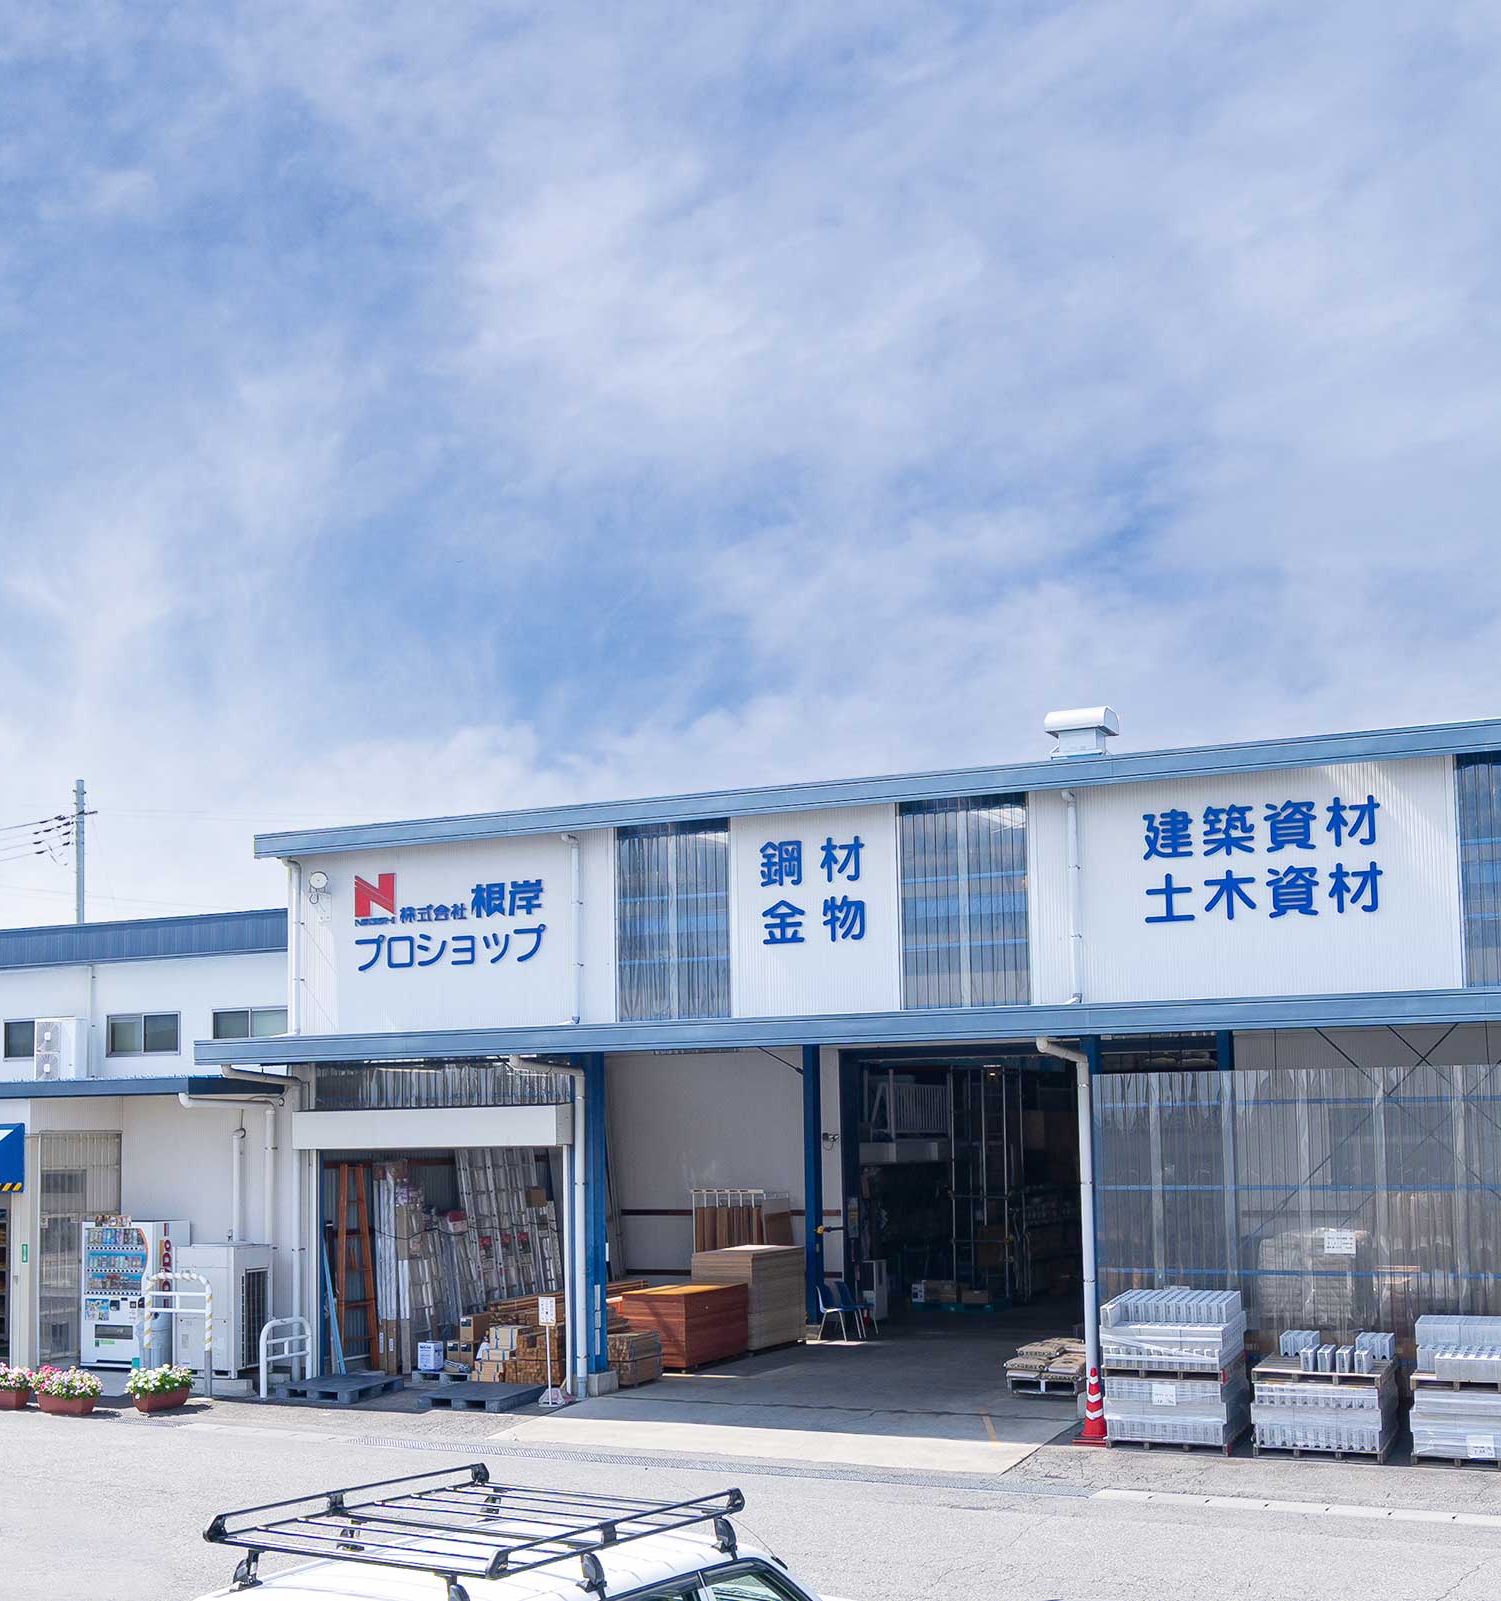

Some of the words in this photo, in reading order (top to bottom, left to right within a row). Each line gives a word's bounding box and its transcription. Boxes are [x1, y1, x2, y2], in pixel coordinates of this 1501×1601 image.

[1142, 794, 1381, 861] 建築資材
[759, 836, 865, 888] 鋼材
[399, 903, 468, 924] 株式会社
[471, 879, 543, 918] 根岸
[1144, 861, 1383, 924] 土木資材
[762, 896, 866, 946] 金物
[355, 923, 546, 972] プロショップ
